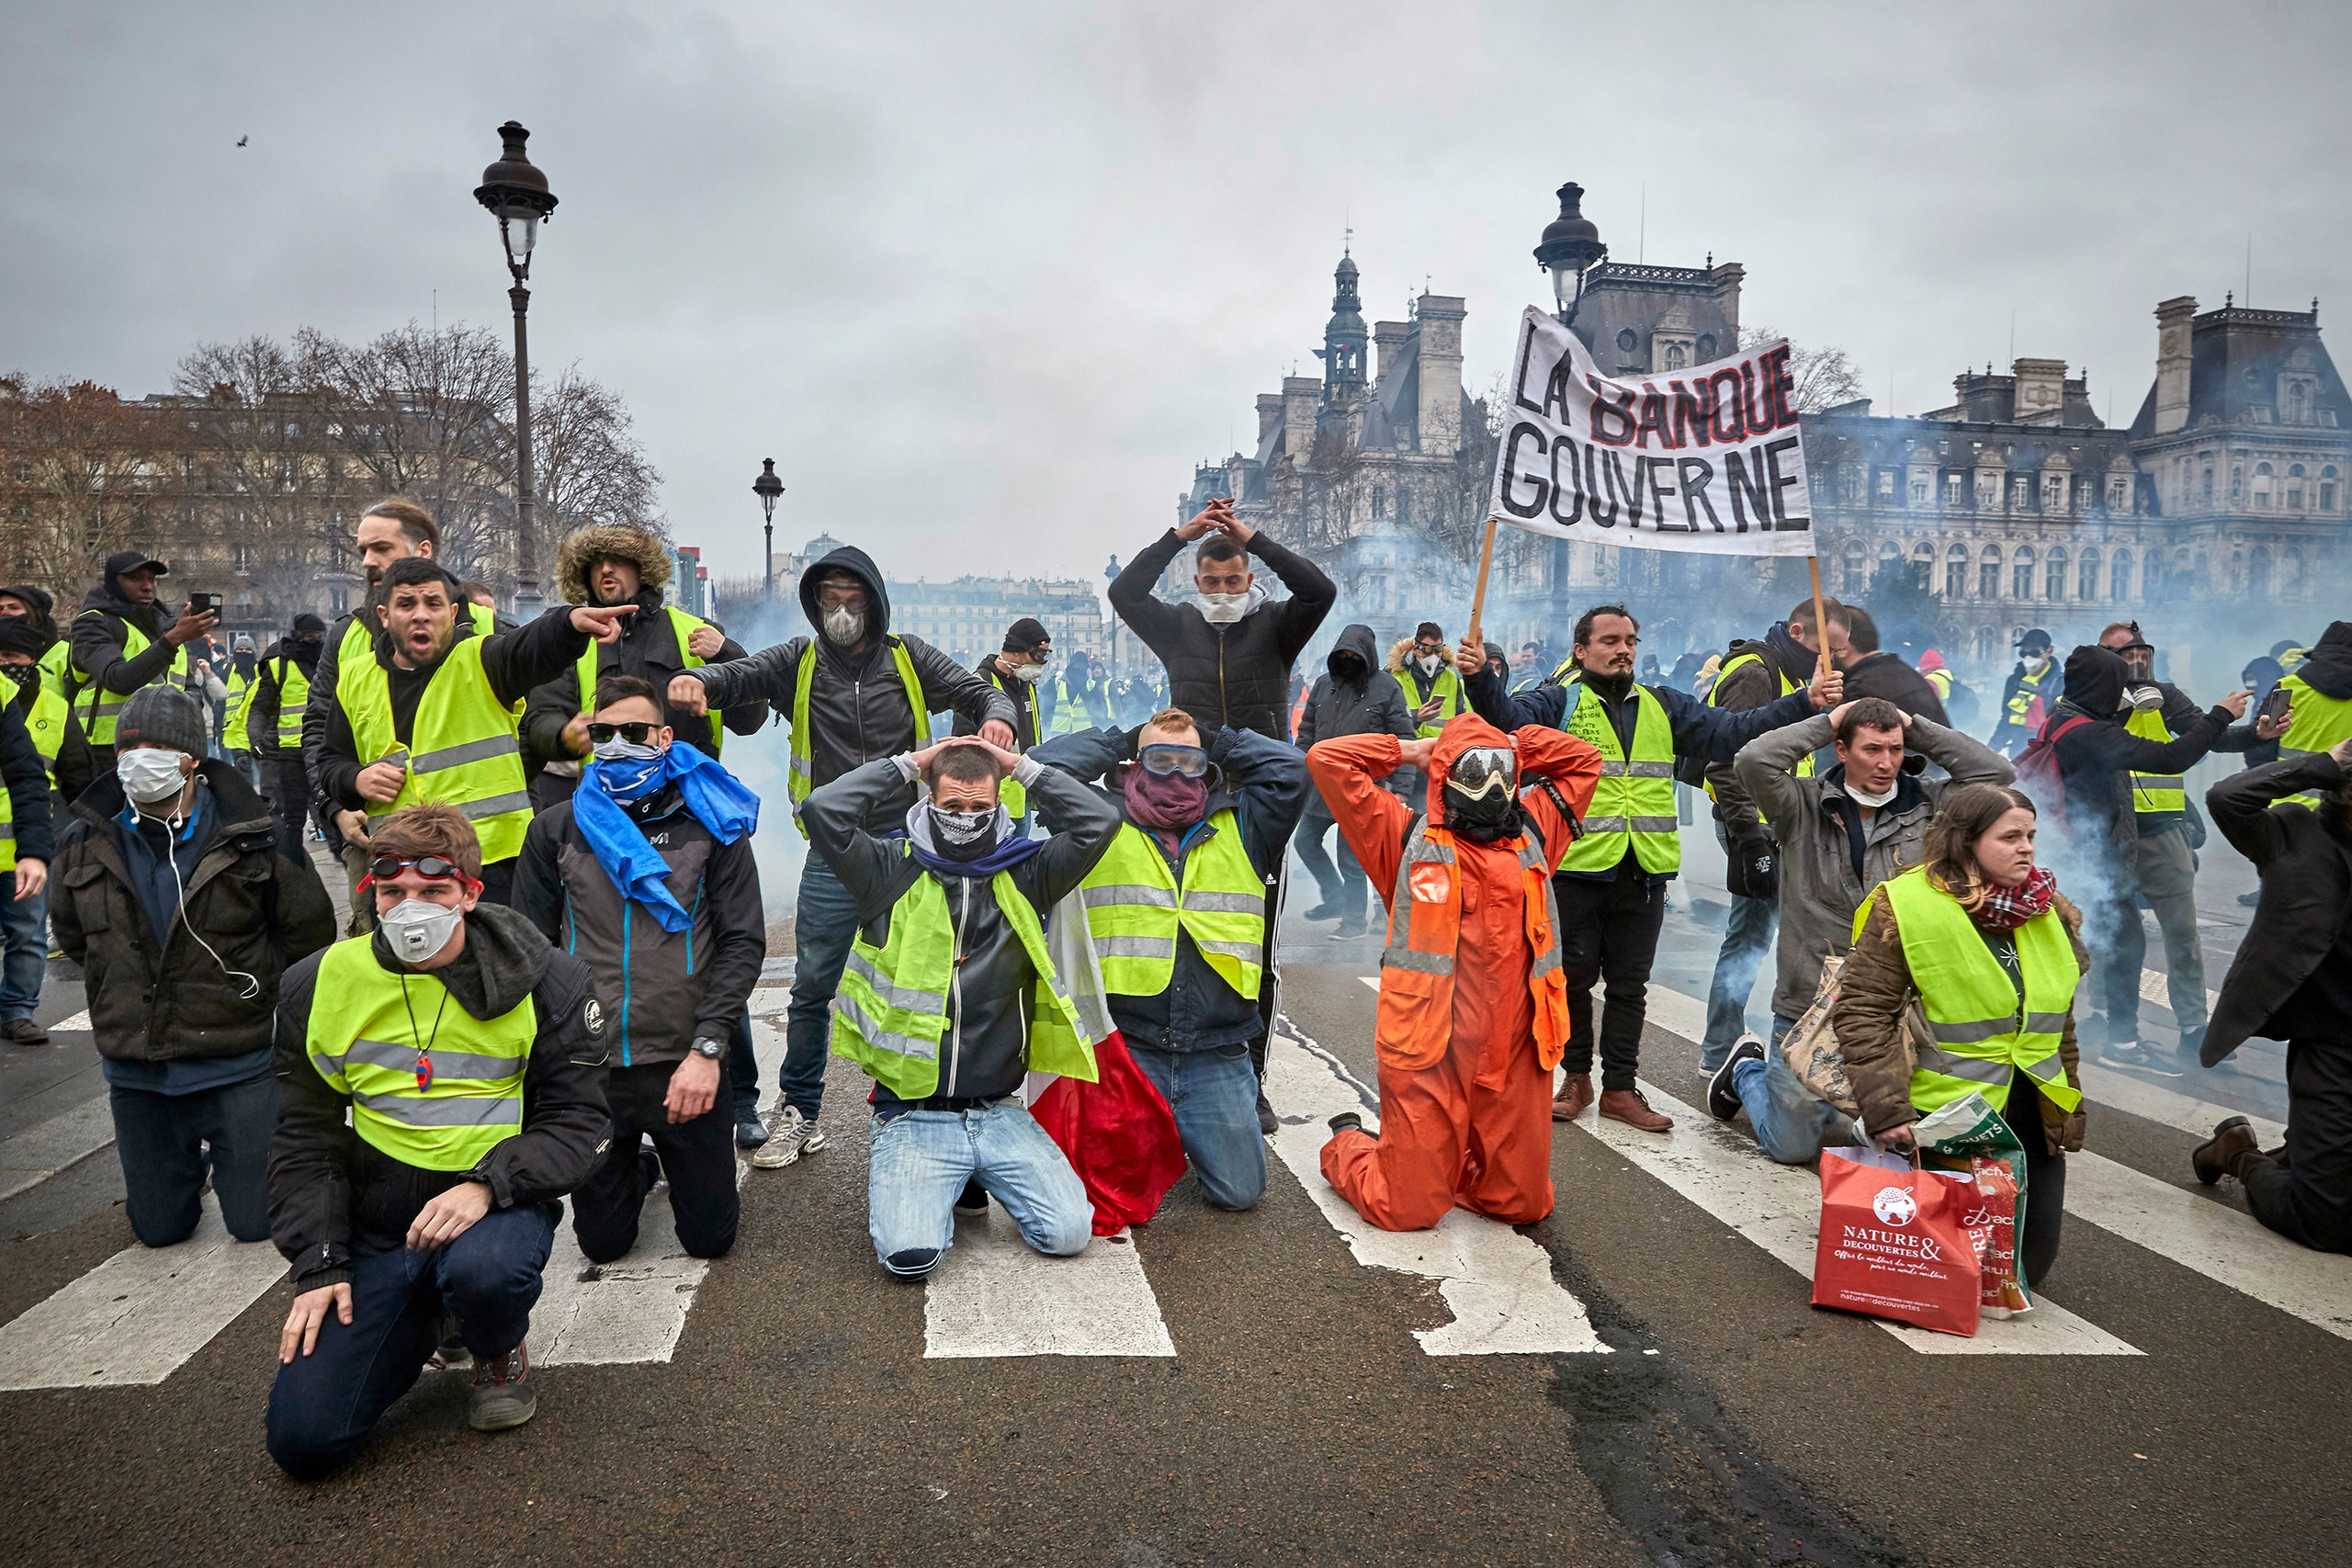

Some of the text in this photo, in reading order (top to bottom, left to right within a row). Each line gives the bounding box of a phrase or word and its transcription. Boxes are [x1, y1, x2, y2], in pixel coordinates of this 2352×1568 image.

[1516, 322, 1799, 449] LA BANQUE
[1501, 422, 1810, 533] GOUVERNE
[1843, 1224, 1942, 1261] NATURE &
[1843, 1239, 1919, 1258] DECOUVERTES
